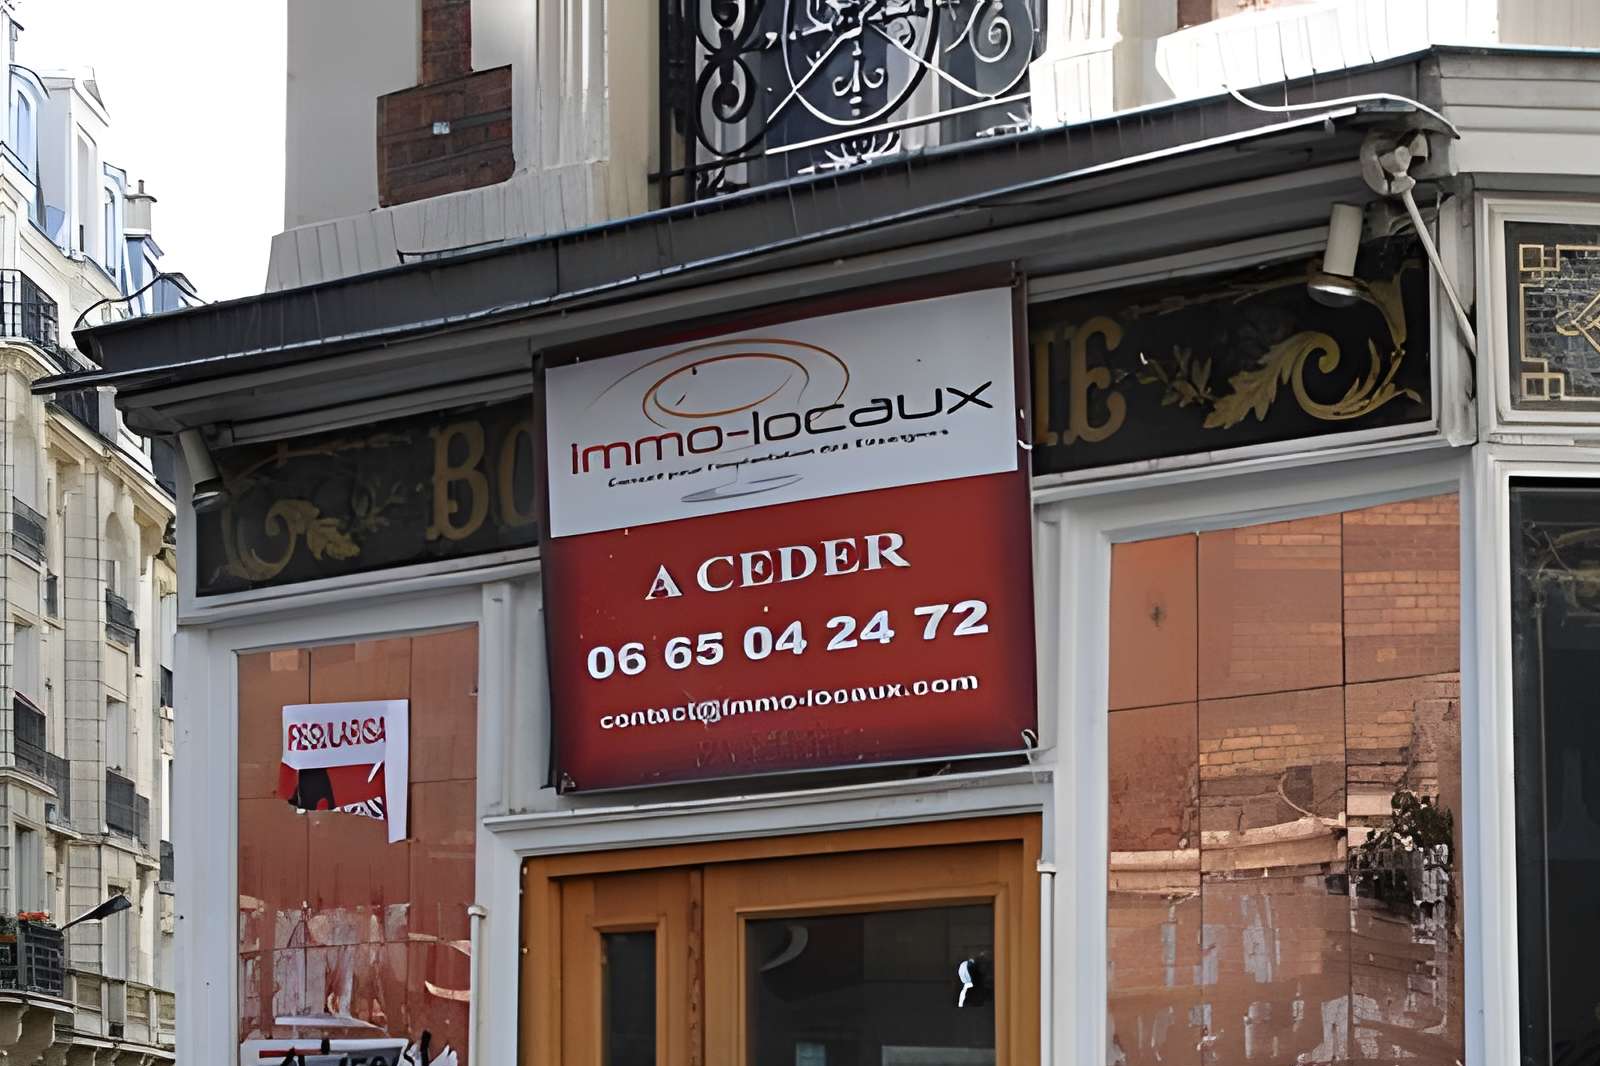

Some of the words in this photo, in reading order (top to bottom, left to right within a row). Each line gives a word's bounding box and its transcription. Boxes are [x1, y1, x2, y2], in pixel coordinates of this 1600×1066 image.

[696, 532, 912, 593] CEDER
[586, 643, 648, 680] 06
[663, 631, 724, 668] 65
[742, 620, 808, 657] 04
[825, 609, 895, 652] 24
[913, 599, 990, 640] 72
